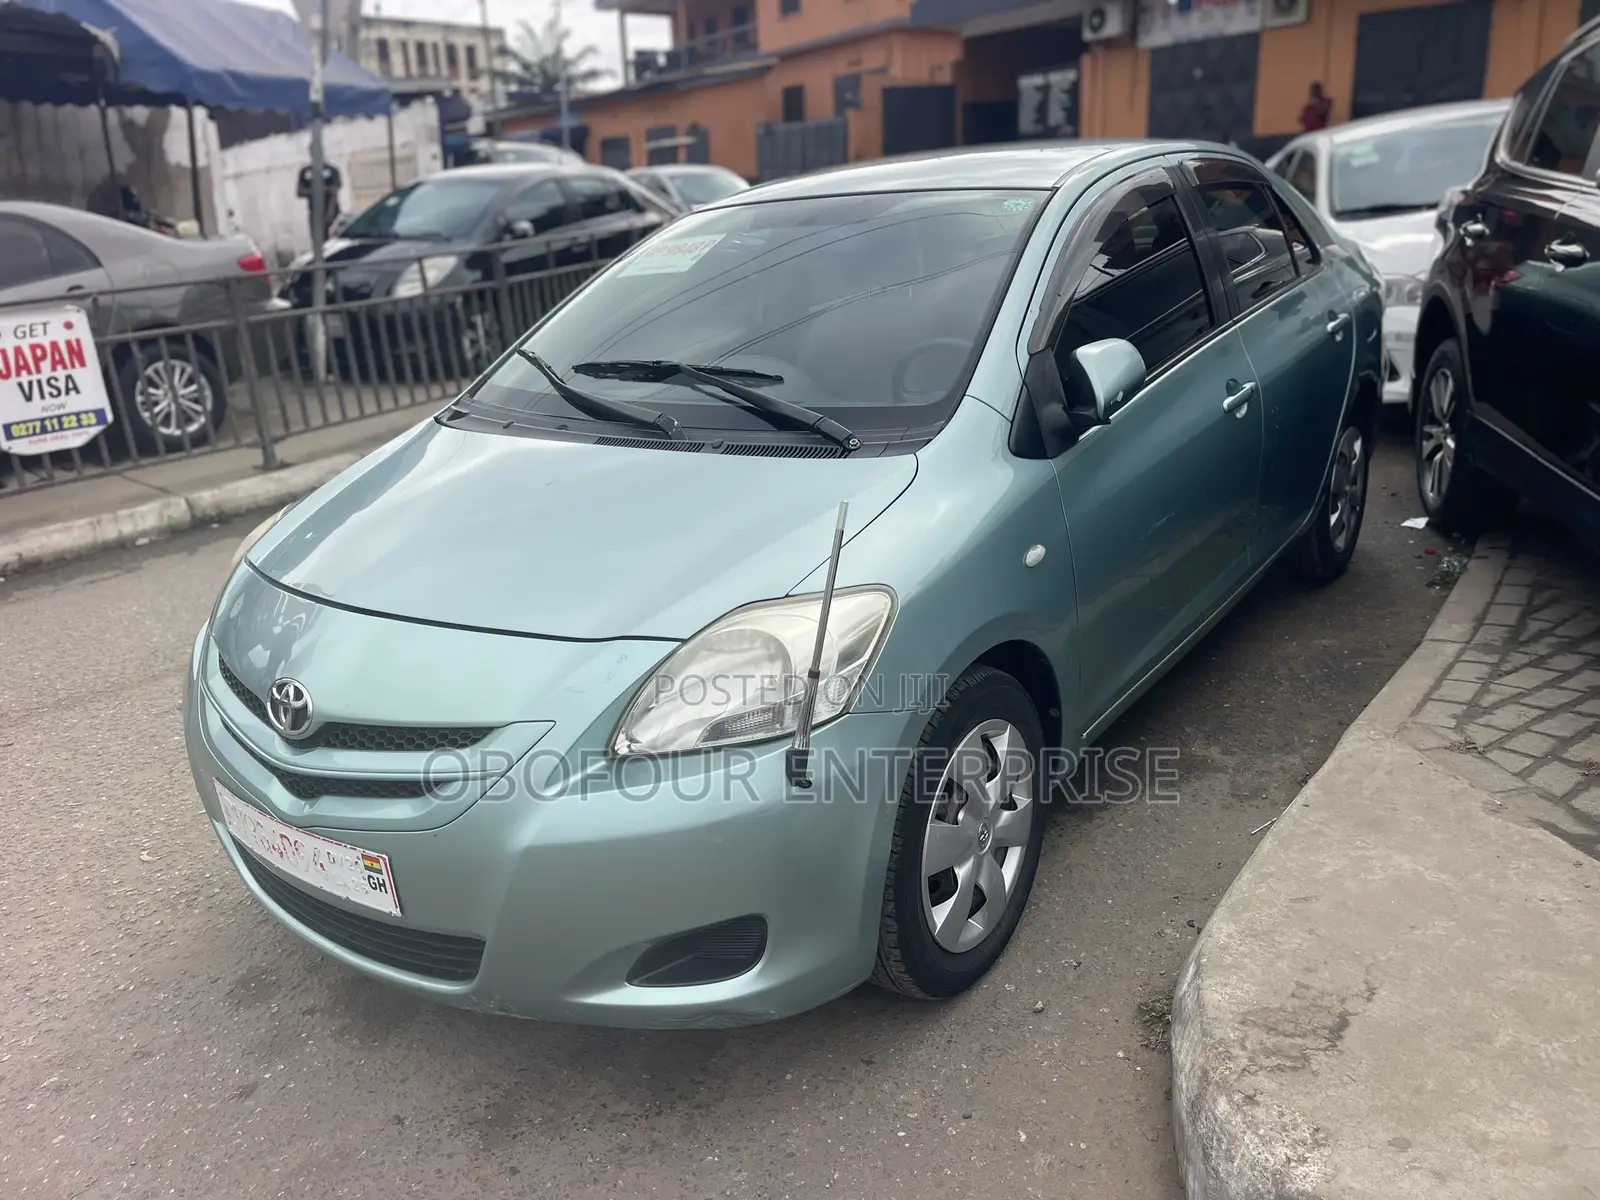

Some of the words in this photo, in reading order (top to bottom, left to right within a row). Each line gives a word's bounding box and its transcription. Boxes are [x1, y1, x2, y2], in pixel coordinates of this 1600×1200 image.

[13, 321, 50, 340] GET
[0, 338, 86, 380] JAPAN
[17, 374, 81, 402] VISA
[41, 403, 67, 413] NOW
[11, 420, 41, 437] 0277
[44, 416, 59, 432] 11
[61, 414, 78, 428] 22
[367, 875, 388, 894] GH
